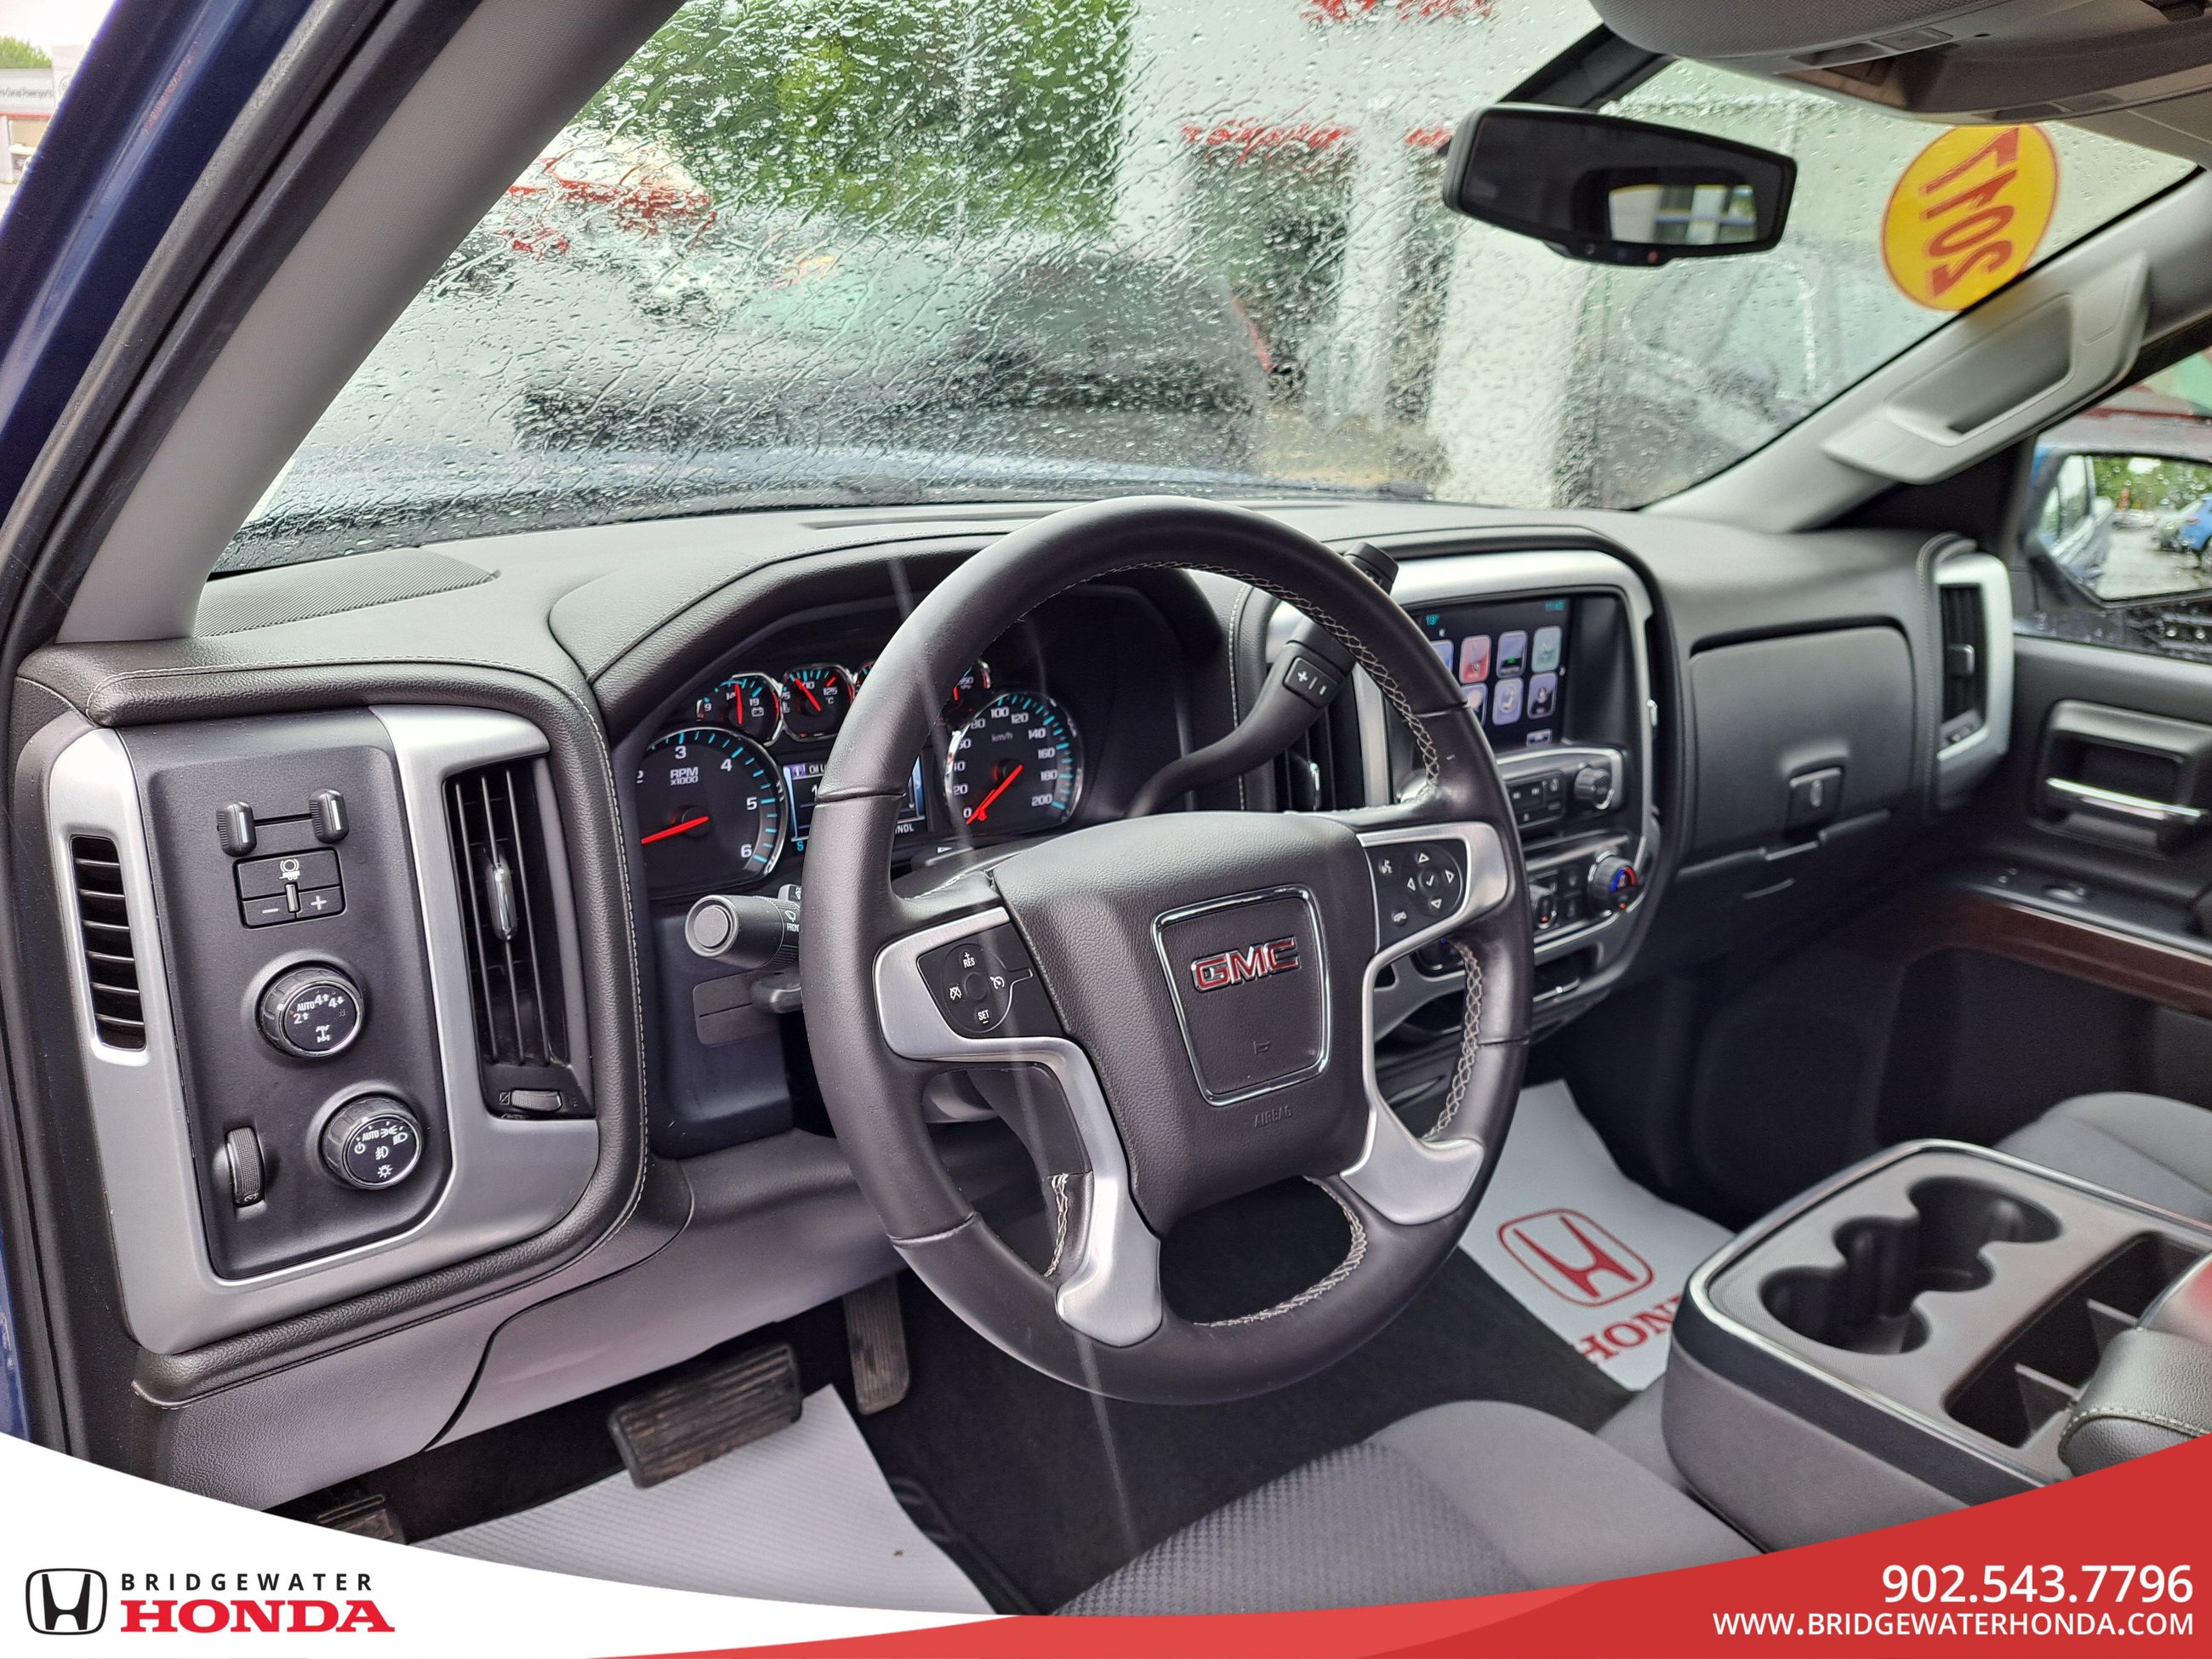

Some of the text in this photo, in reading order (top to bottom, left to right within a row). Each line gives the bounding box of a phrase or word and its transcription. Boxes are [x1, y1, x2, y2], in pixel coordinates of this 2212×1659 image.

[823, 687, 838, 696] 125
[704, 703, 712, 712] 9
[750, 698, 760, 707] 19
[990, 707, 1010, 719] 100
[1011, 712, 1029, 724] 120
[971, 718, 986, 730] 80
[1028, 727, 1046, 740] 140
[675, 746, 687, 759] 3
[1038, 747, 1056, 759] 160
[721, 758, 733, 772] 4
[670, 767, 698, 778] RPM
[1040, 769, 1058, 782] 180
[953, 784, 968, 795] 20
[746, 797, 757, 810] 5
[1031, 795, 1053, 807] 200
[963, 807, 972, 818] 0
[741, 844, 752, 858] 6
[796, 841, 804, 851] S
[786, 922, 800, 932] FRON
[963, 957, 975, 968] RES
[1191, 935, 1302, 993] GMC
[297, 1001, 315, 1012] AUTO
[314, 995, 323, 1006] 4
[328, 997, 338, 1008] 4
[294, 1012, 303, 1024] 2
[978, 1010, 989, 1020] SET
[1254, 1105, 1293, 1128] AIRBAG
[362, 1130, 379, 1141] AUTO
[1581, 1293, 1681, 1365] HON
